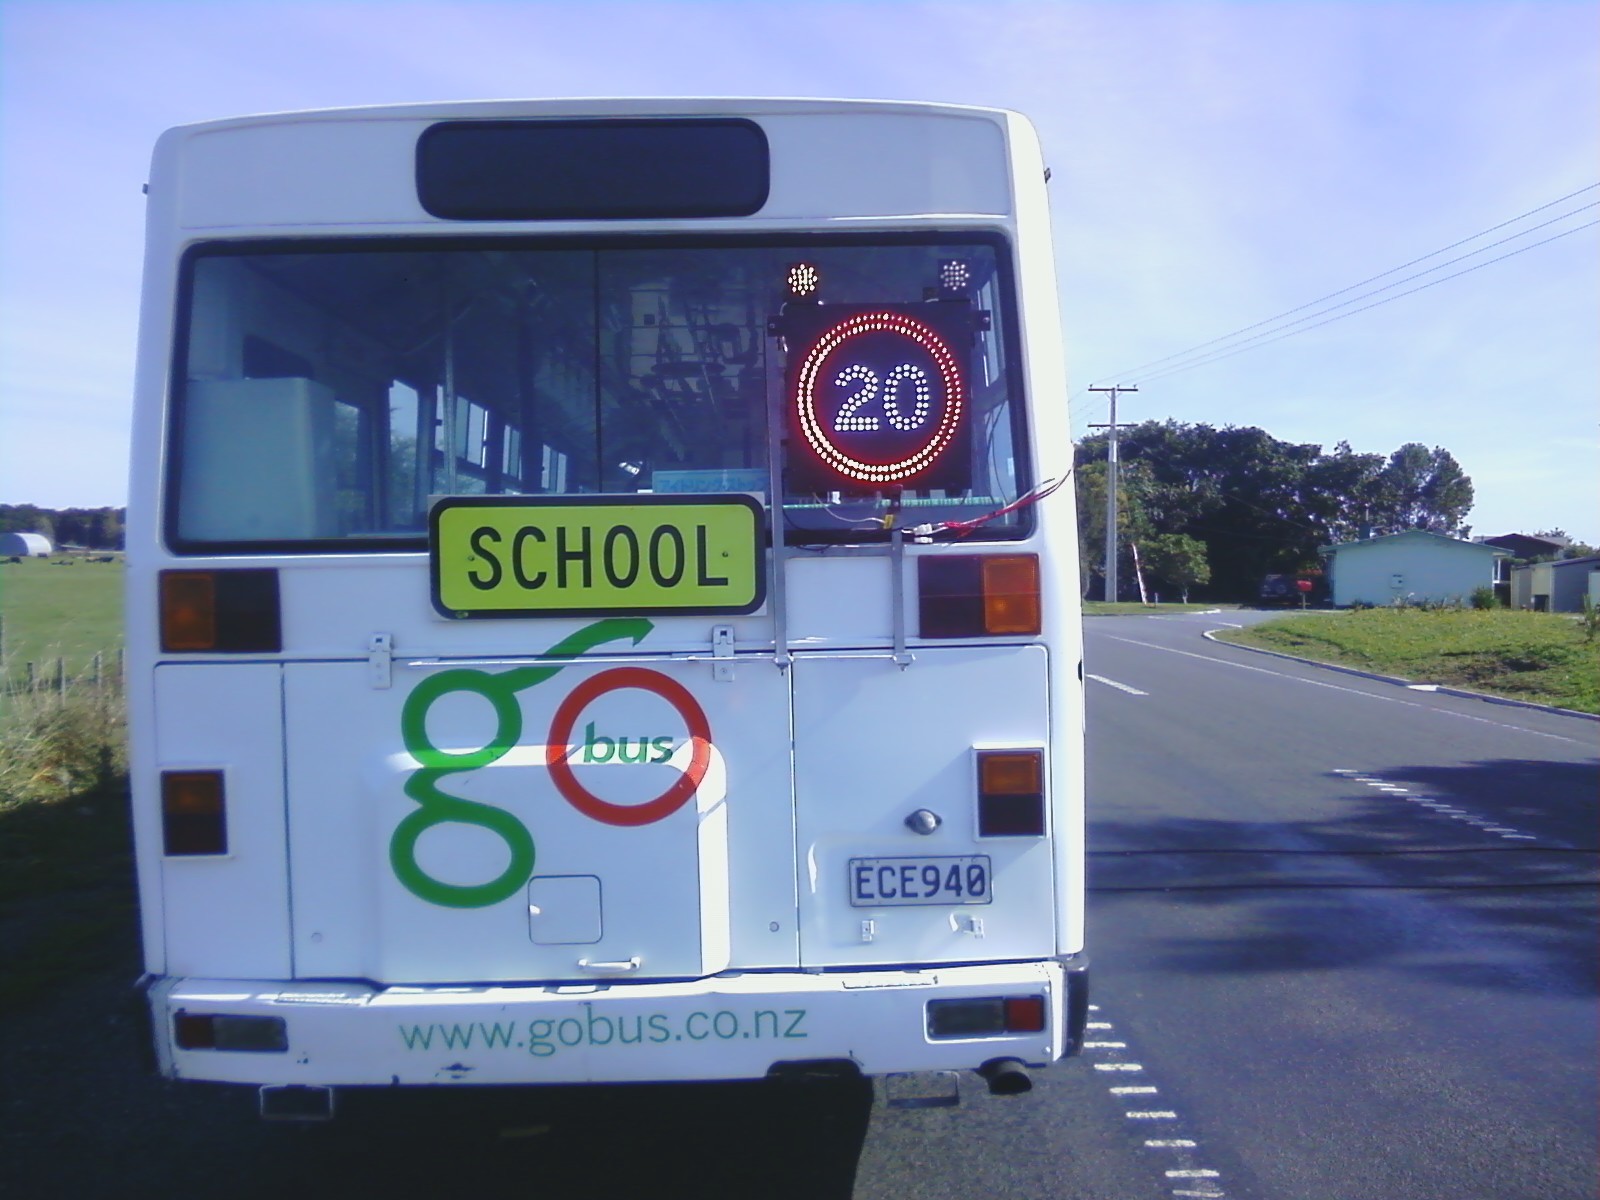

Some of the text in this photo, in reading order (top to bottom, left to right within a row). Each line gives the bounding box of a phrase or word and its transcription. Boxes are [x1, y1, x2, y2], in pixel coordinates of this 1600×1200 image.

[834, 363, 929, 432] 20
[467, 524, 729, 590] SCHOOL
[583, 721, 674, 764] bus
[856, 864, 986, 899] ECE940
[399, 1004, 808, 1057] www.gobus.co.nz
